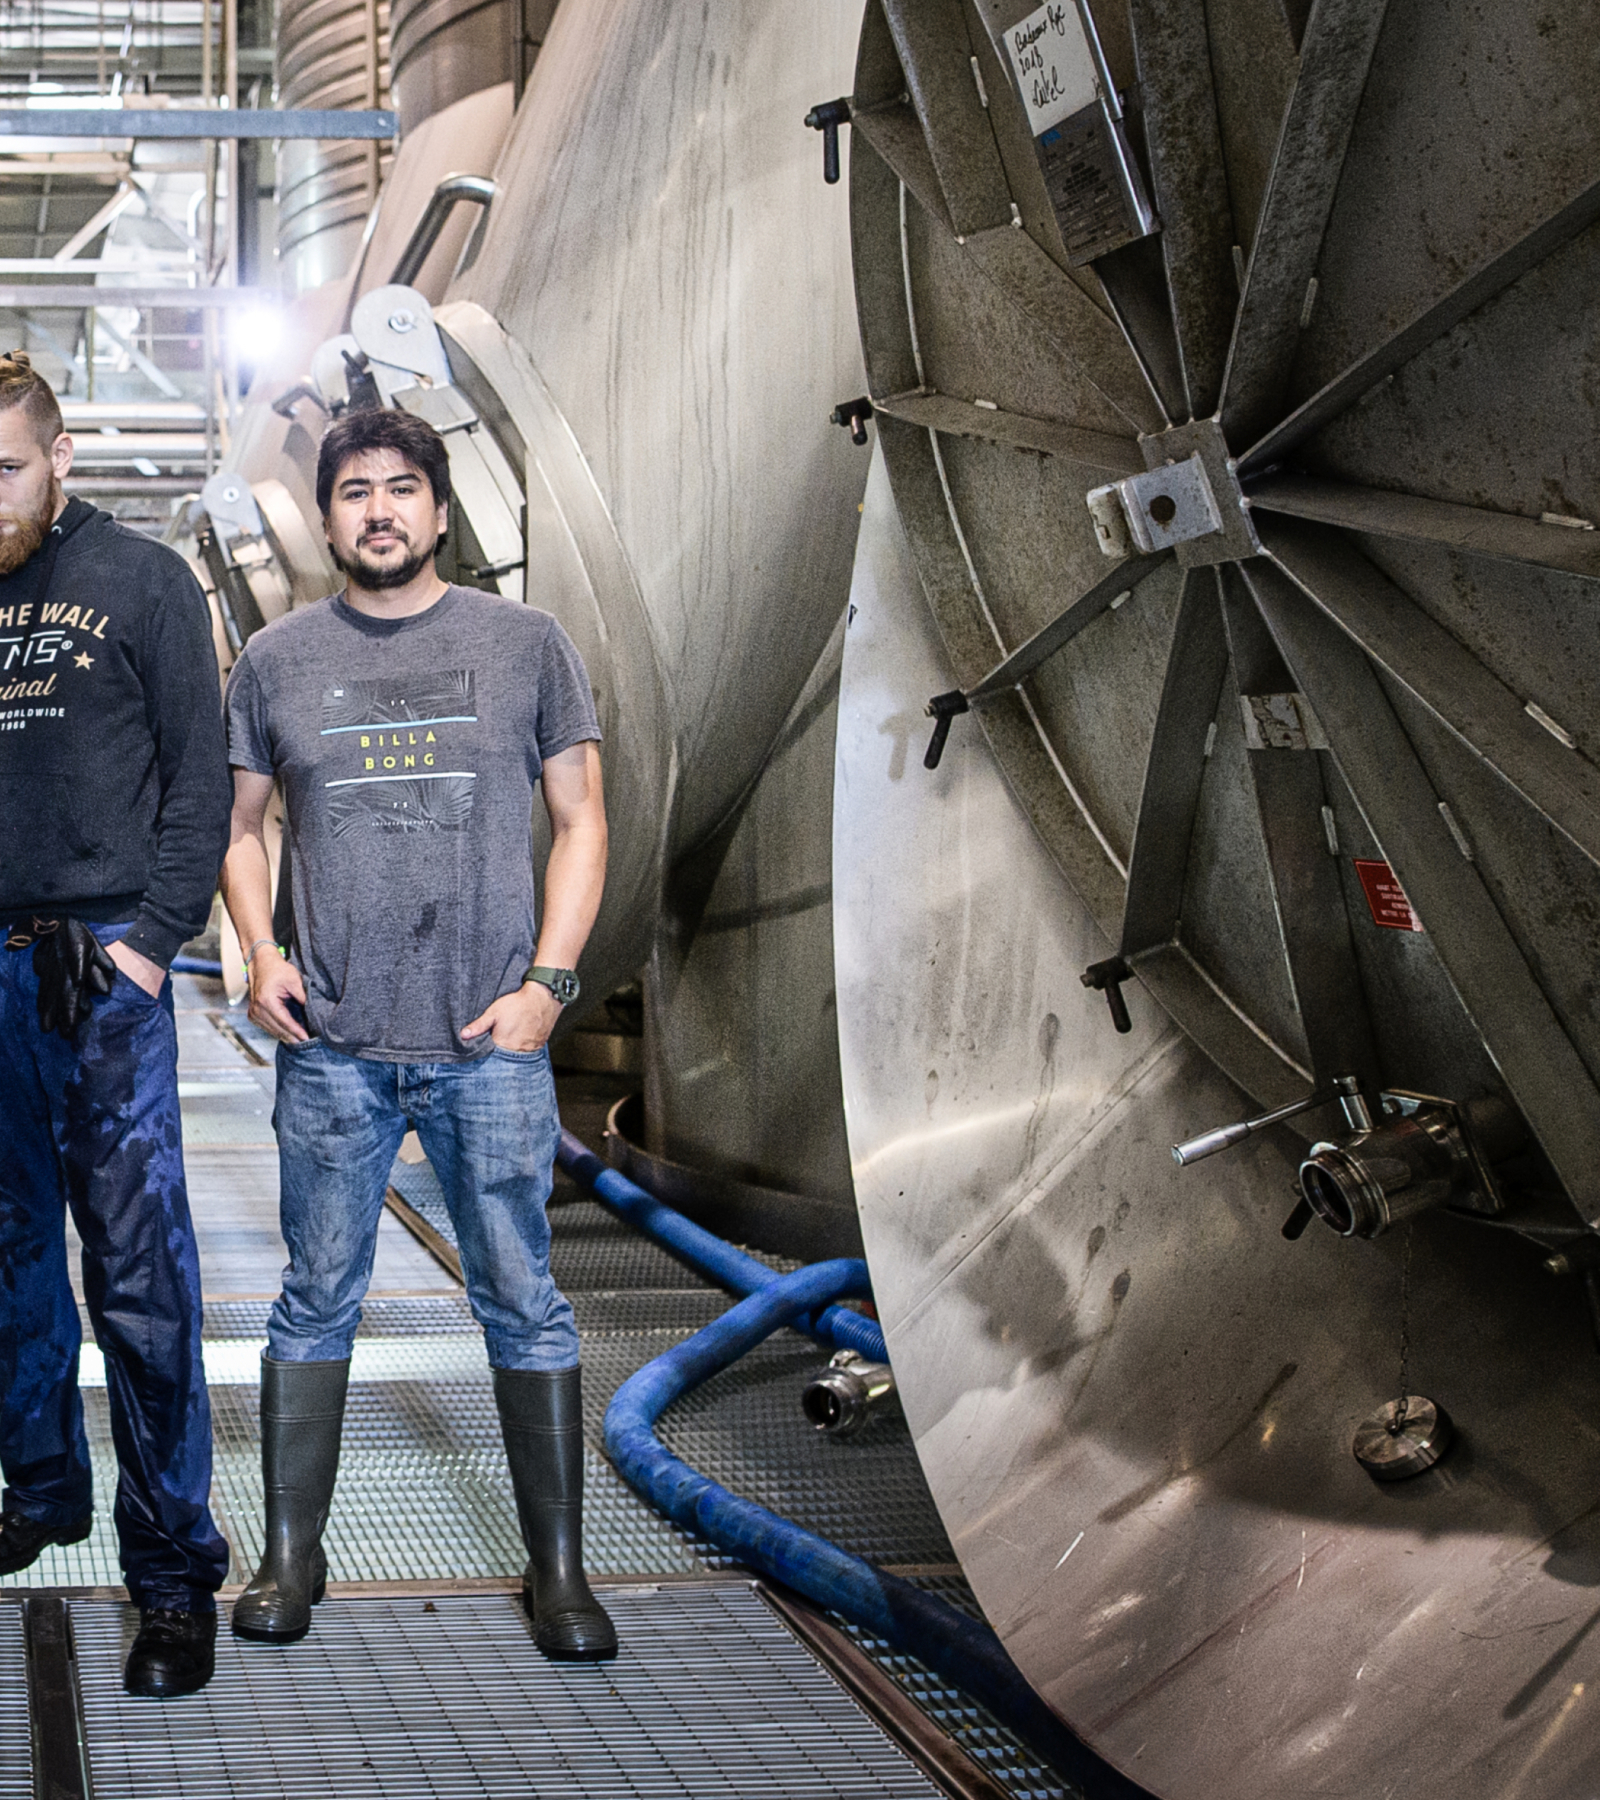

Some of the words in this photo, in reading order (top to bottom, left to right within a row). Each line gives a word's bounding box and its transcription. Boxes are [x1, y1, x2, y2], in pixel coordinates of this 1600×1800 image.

[40, 602, 109, 639] WALL
[360, 731, 437, 748] BILLA
[365, 753, 435, 770] BONG
